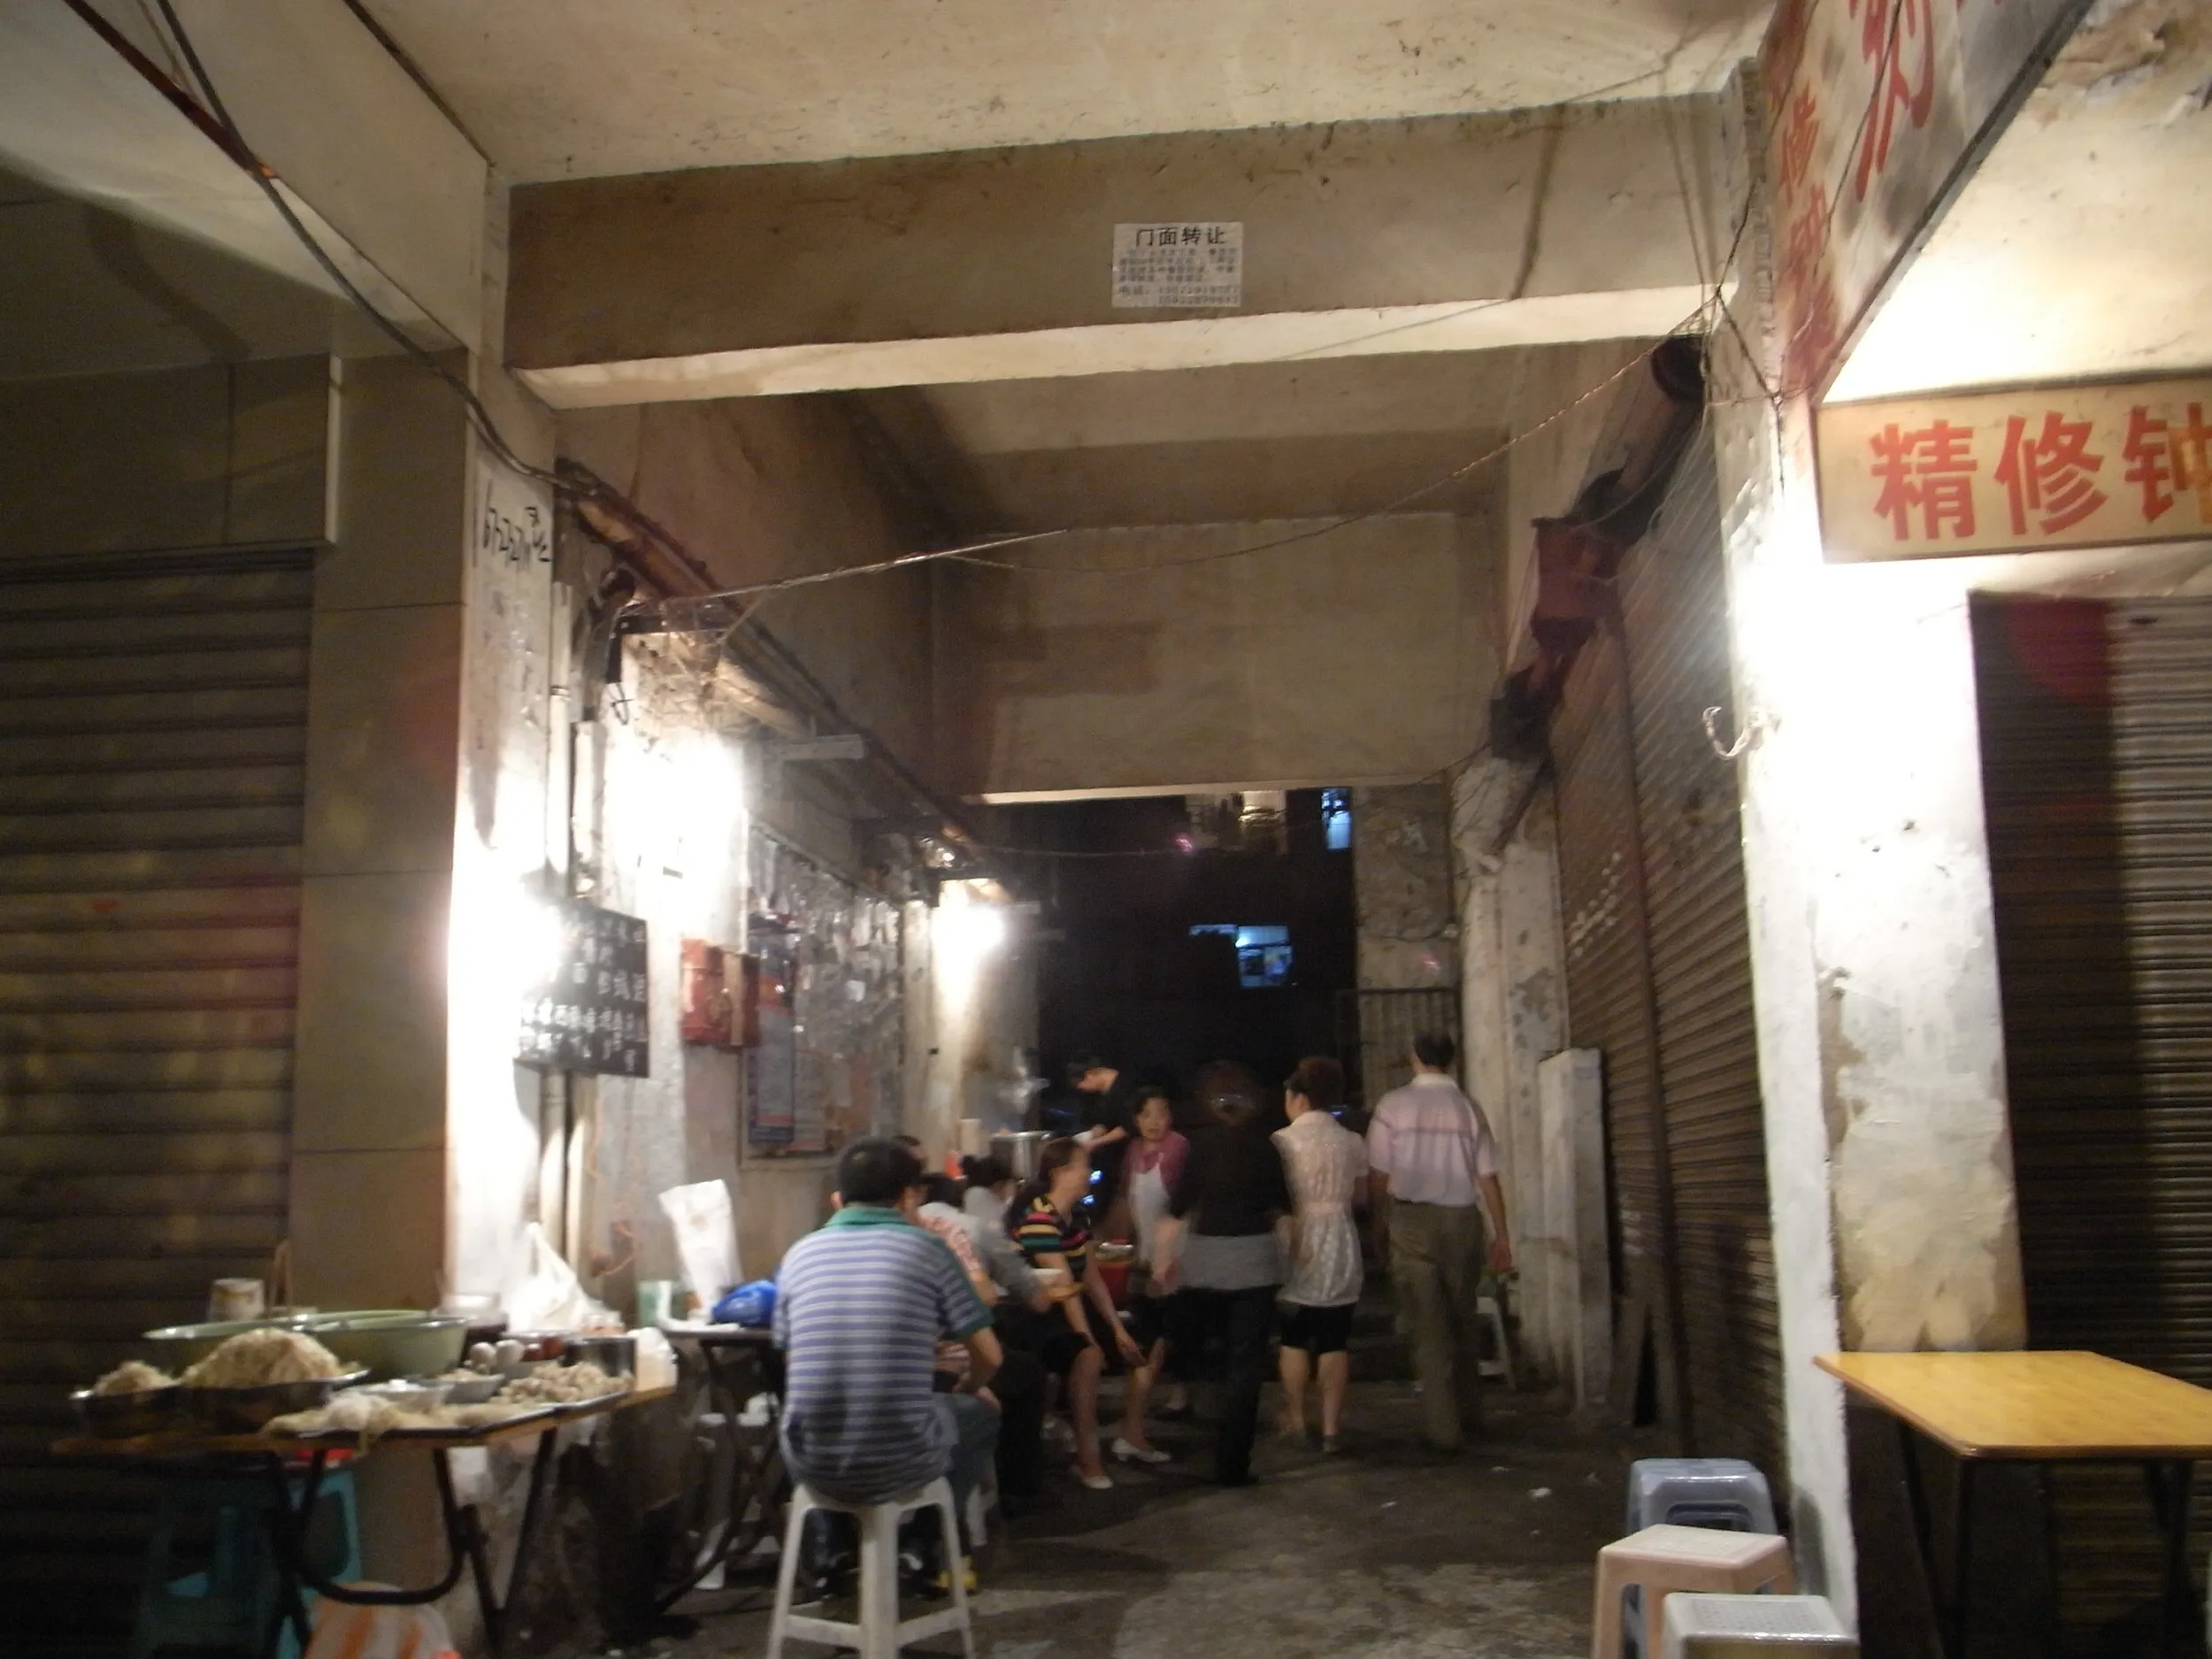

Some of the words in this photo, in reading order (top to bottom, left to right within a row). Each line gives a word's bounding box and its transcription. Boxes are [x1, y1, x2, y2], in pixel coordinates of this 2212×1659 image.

[1135, 226, 1228, 248] 门面转让
[1869, 402, 2212, 541] 精修钟
